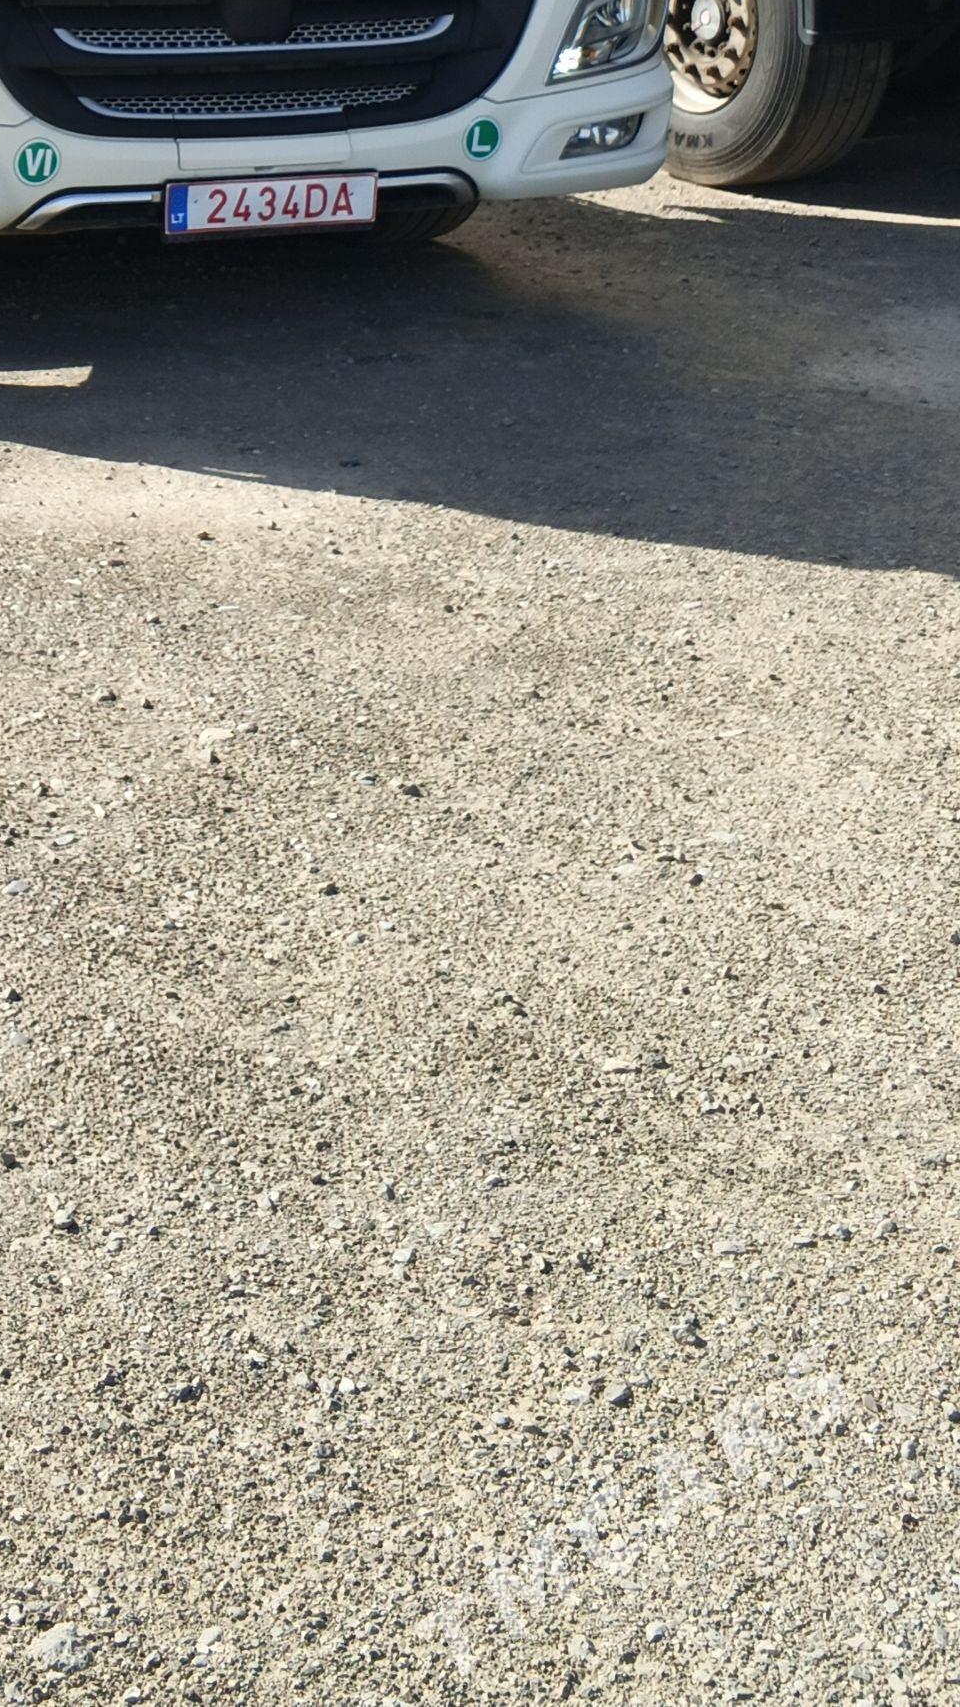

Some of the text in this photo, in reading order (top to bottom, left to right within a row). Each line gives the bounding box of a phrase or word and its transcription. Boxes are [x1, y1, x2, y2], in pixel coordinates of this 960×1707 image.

[471, 125, 491, 152] L
[25, 148, 53, 176] VI
[171, 182, 354, 224] LT 2434DA
